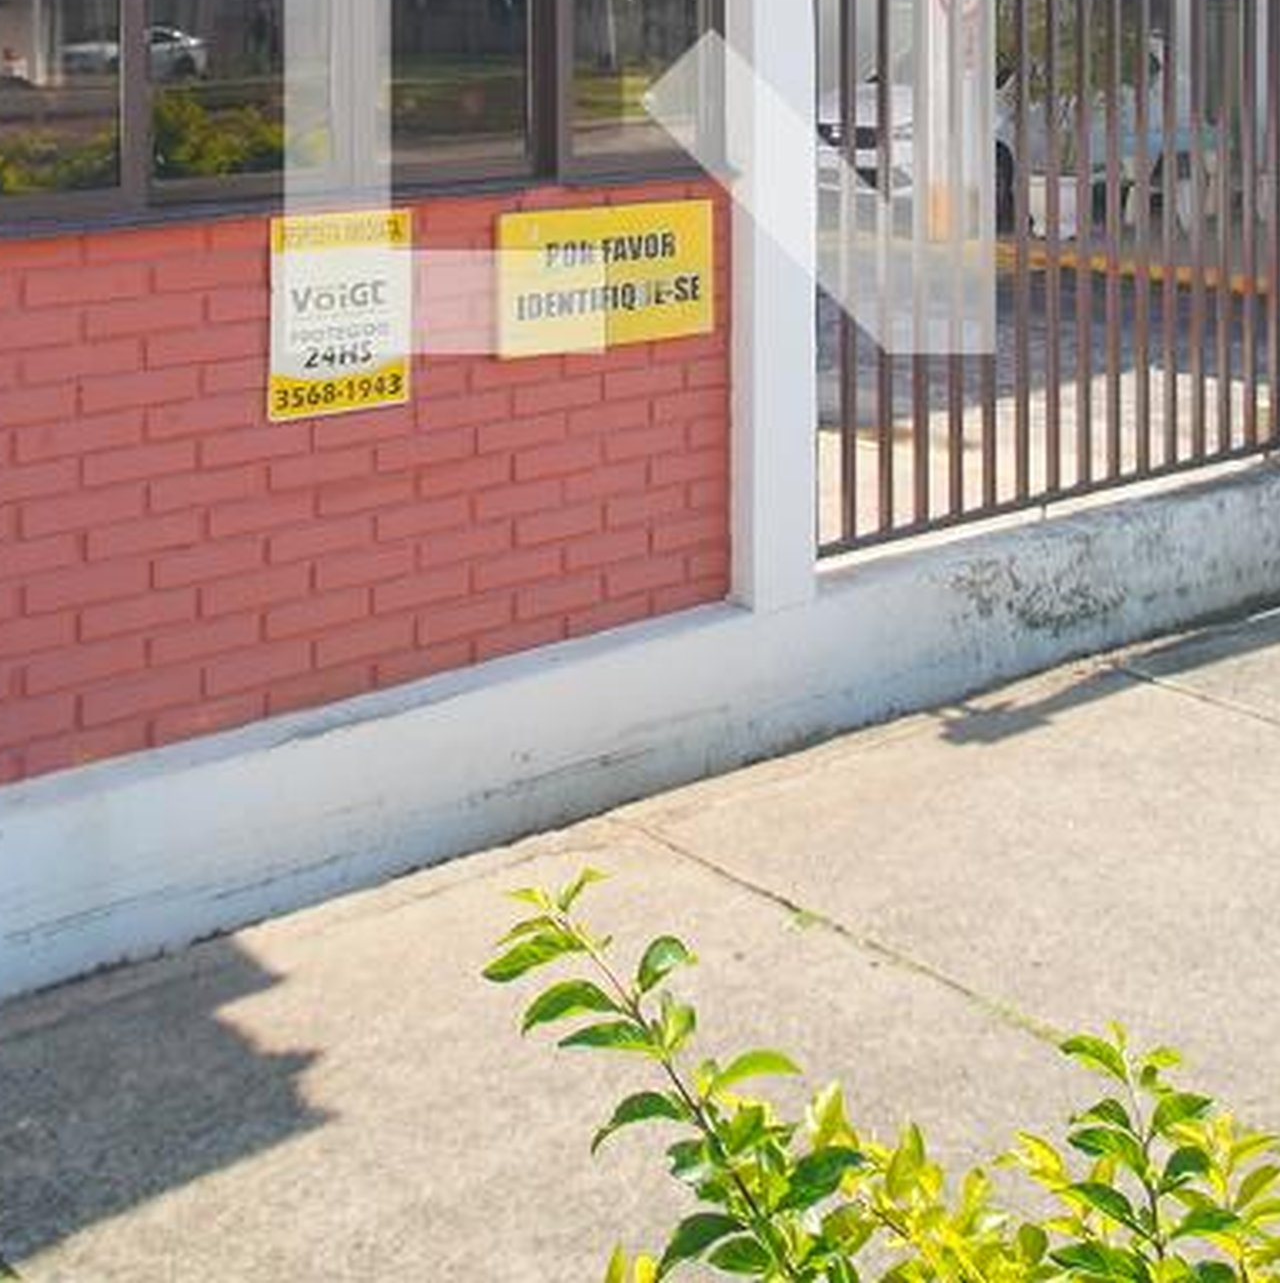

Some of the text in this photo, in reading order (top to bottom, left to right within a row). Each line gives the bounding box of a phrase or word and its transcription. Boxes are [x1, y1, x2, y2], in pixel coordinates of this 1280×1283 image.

[546, 230, 677, 268] POR FAVOR
[274, 372, 402, 411] 3568-1943
